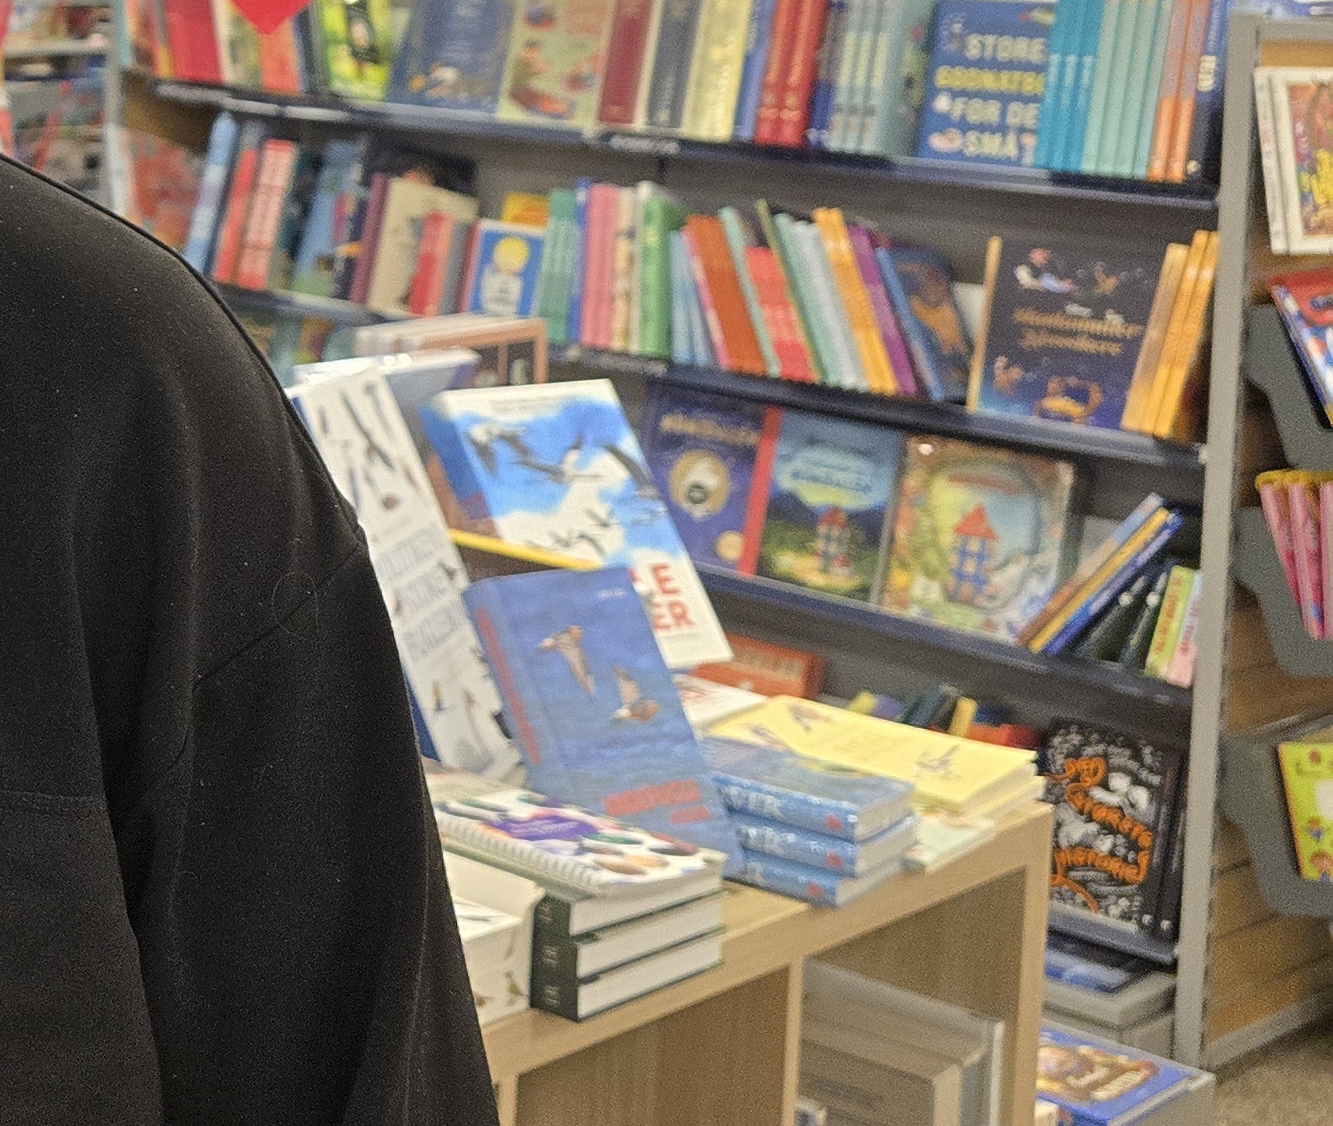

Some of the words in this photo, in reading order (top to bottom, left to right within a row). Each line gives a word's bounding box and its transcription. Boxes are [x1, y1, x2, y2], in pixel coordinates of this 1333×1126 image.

[965, 34, 1046, 64] STORE
[951, 97, 1002, 126] FOR
[1006, 101, 1040, 128] DE
